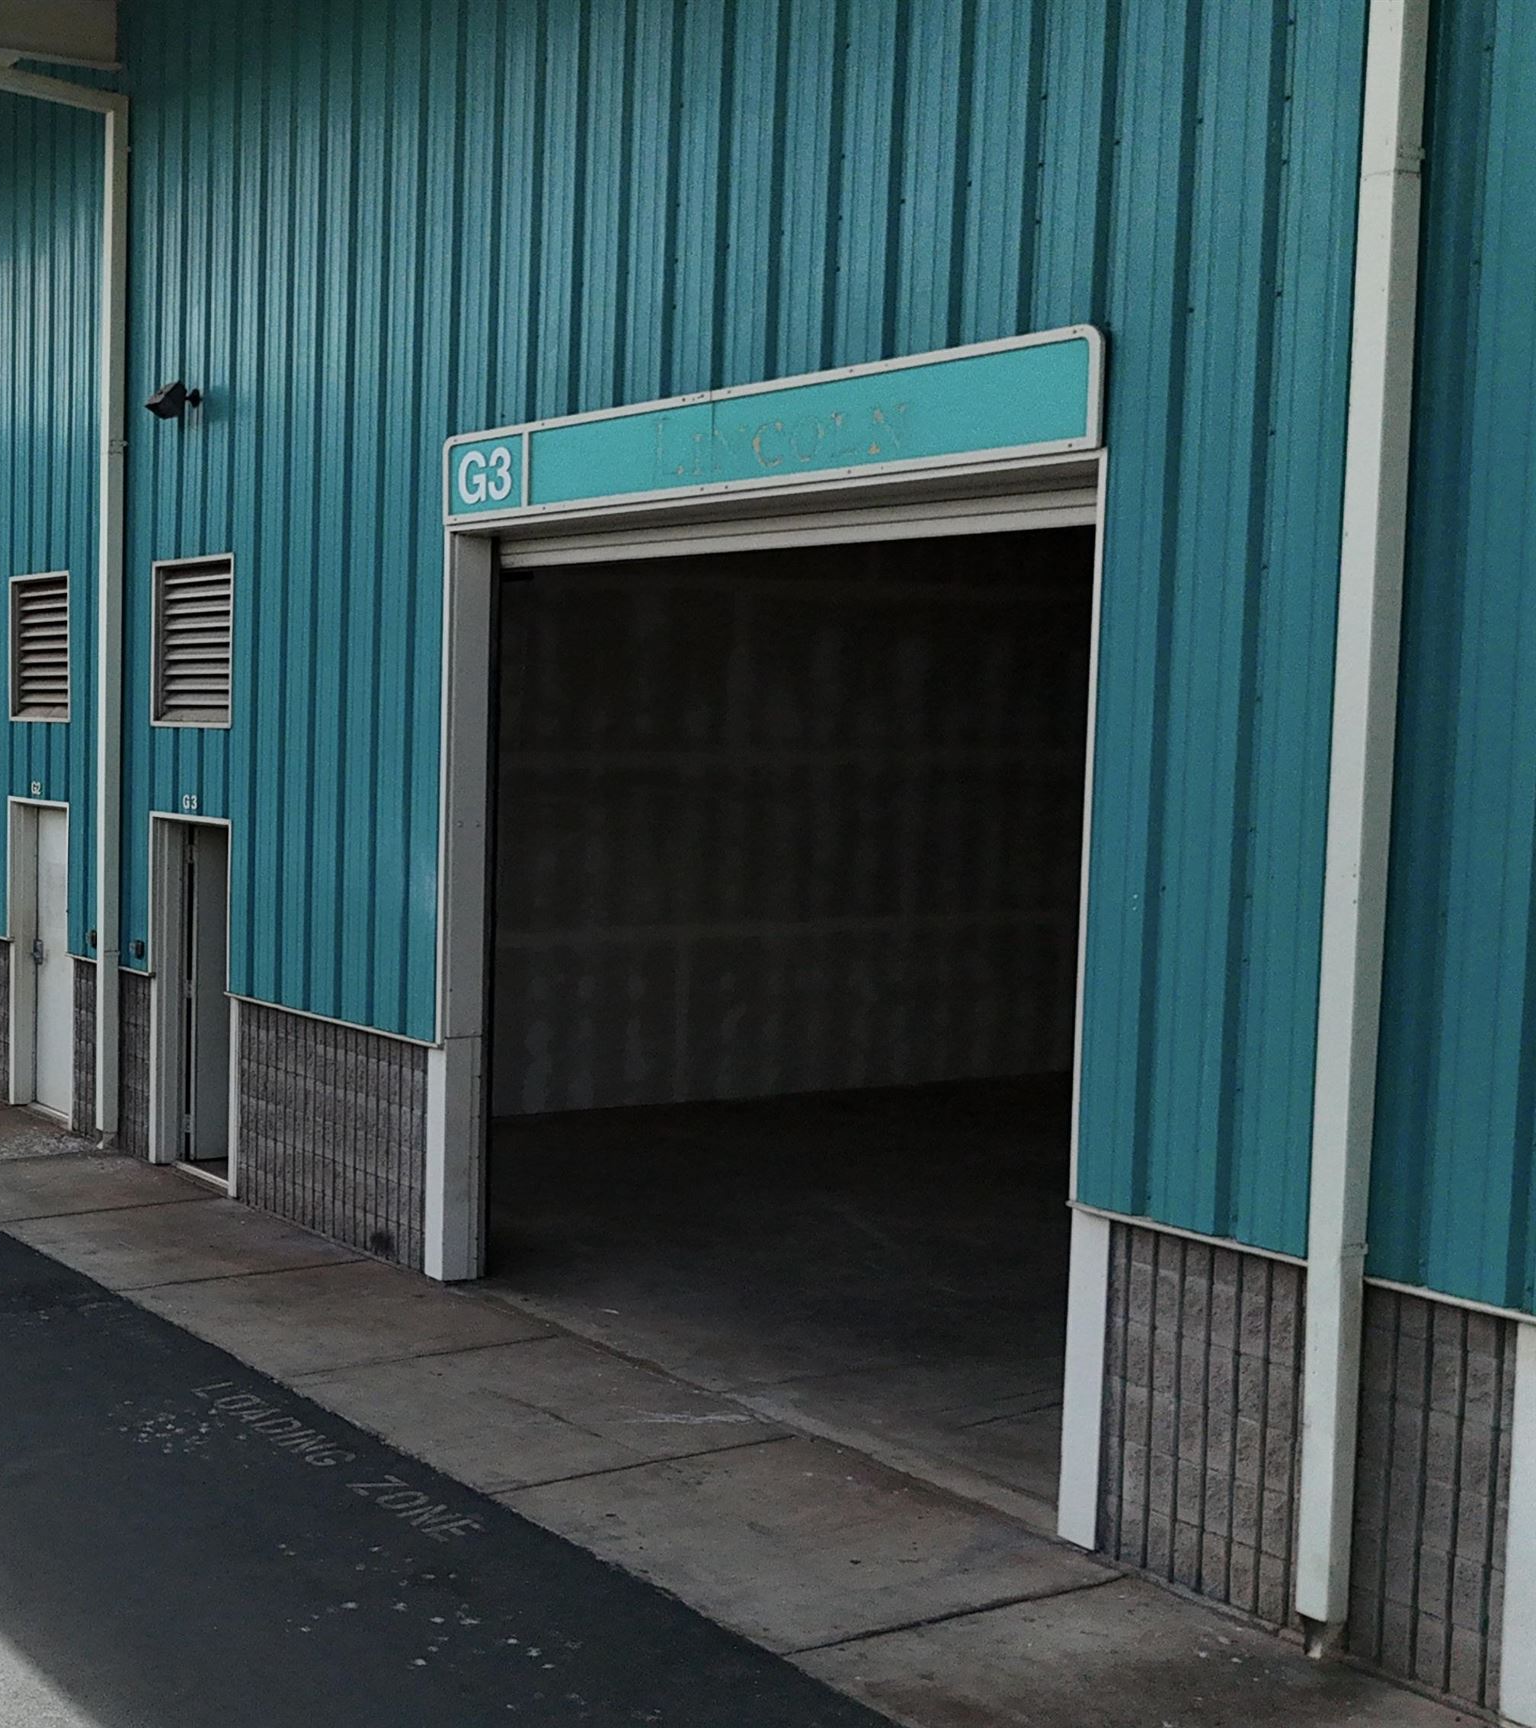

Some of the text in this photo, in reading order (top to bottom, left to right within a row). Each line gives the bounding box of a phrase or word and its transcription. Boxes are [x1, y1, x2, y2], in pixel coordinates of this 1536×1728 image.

[457, 446, 511, 504] G3
[30, 780, 41, 796] G2
[182, 794, 198, 811] G3
[189, 1379, 486, 1543] LOADING ZONE
